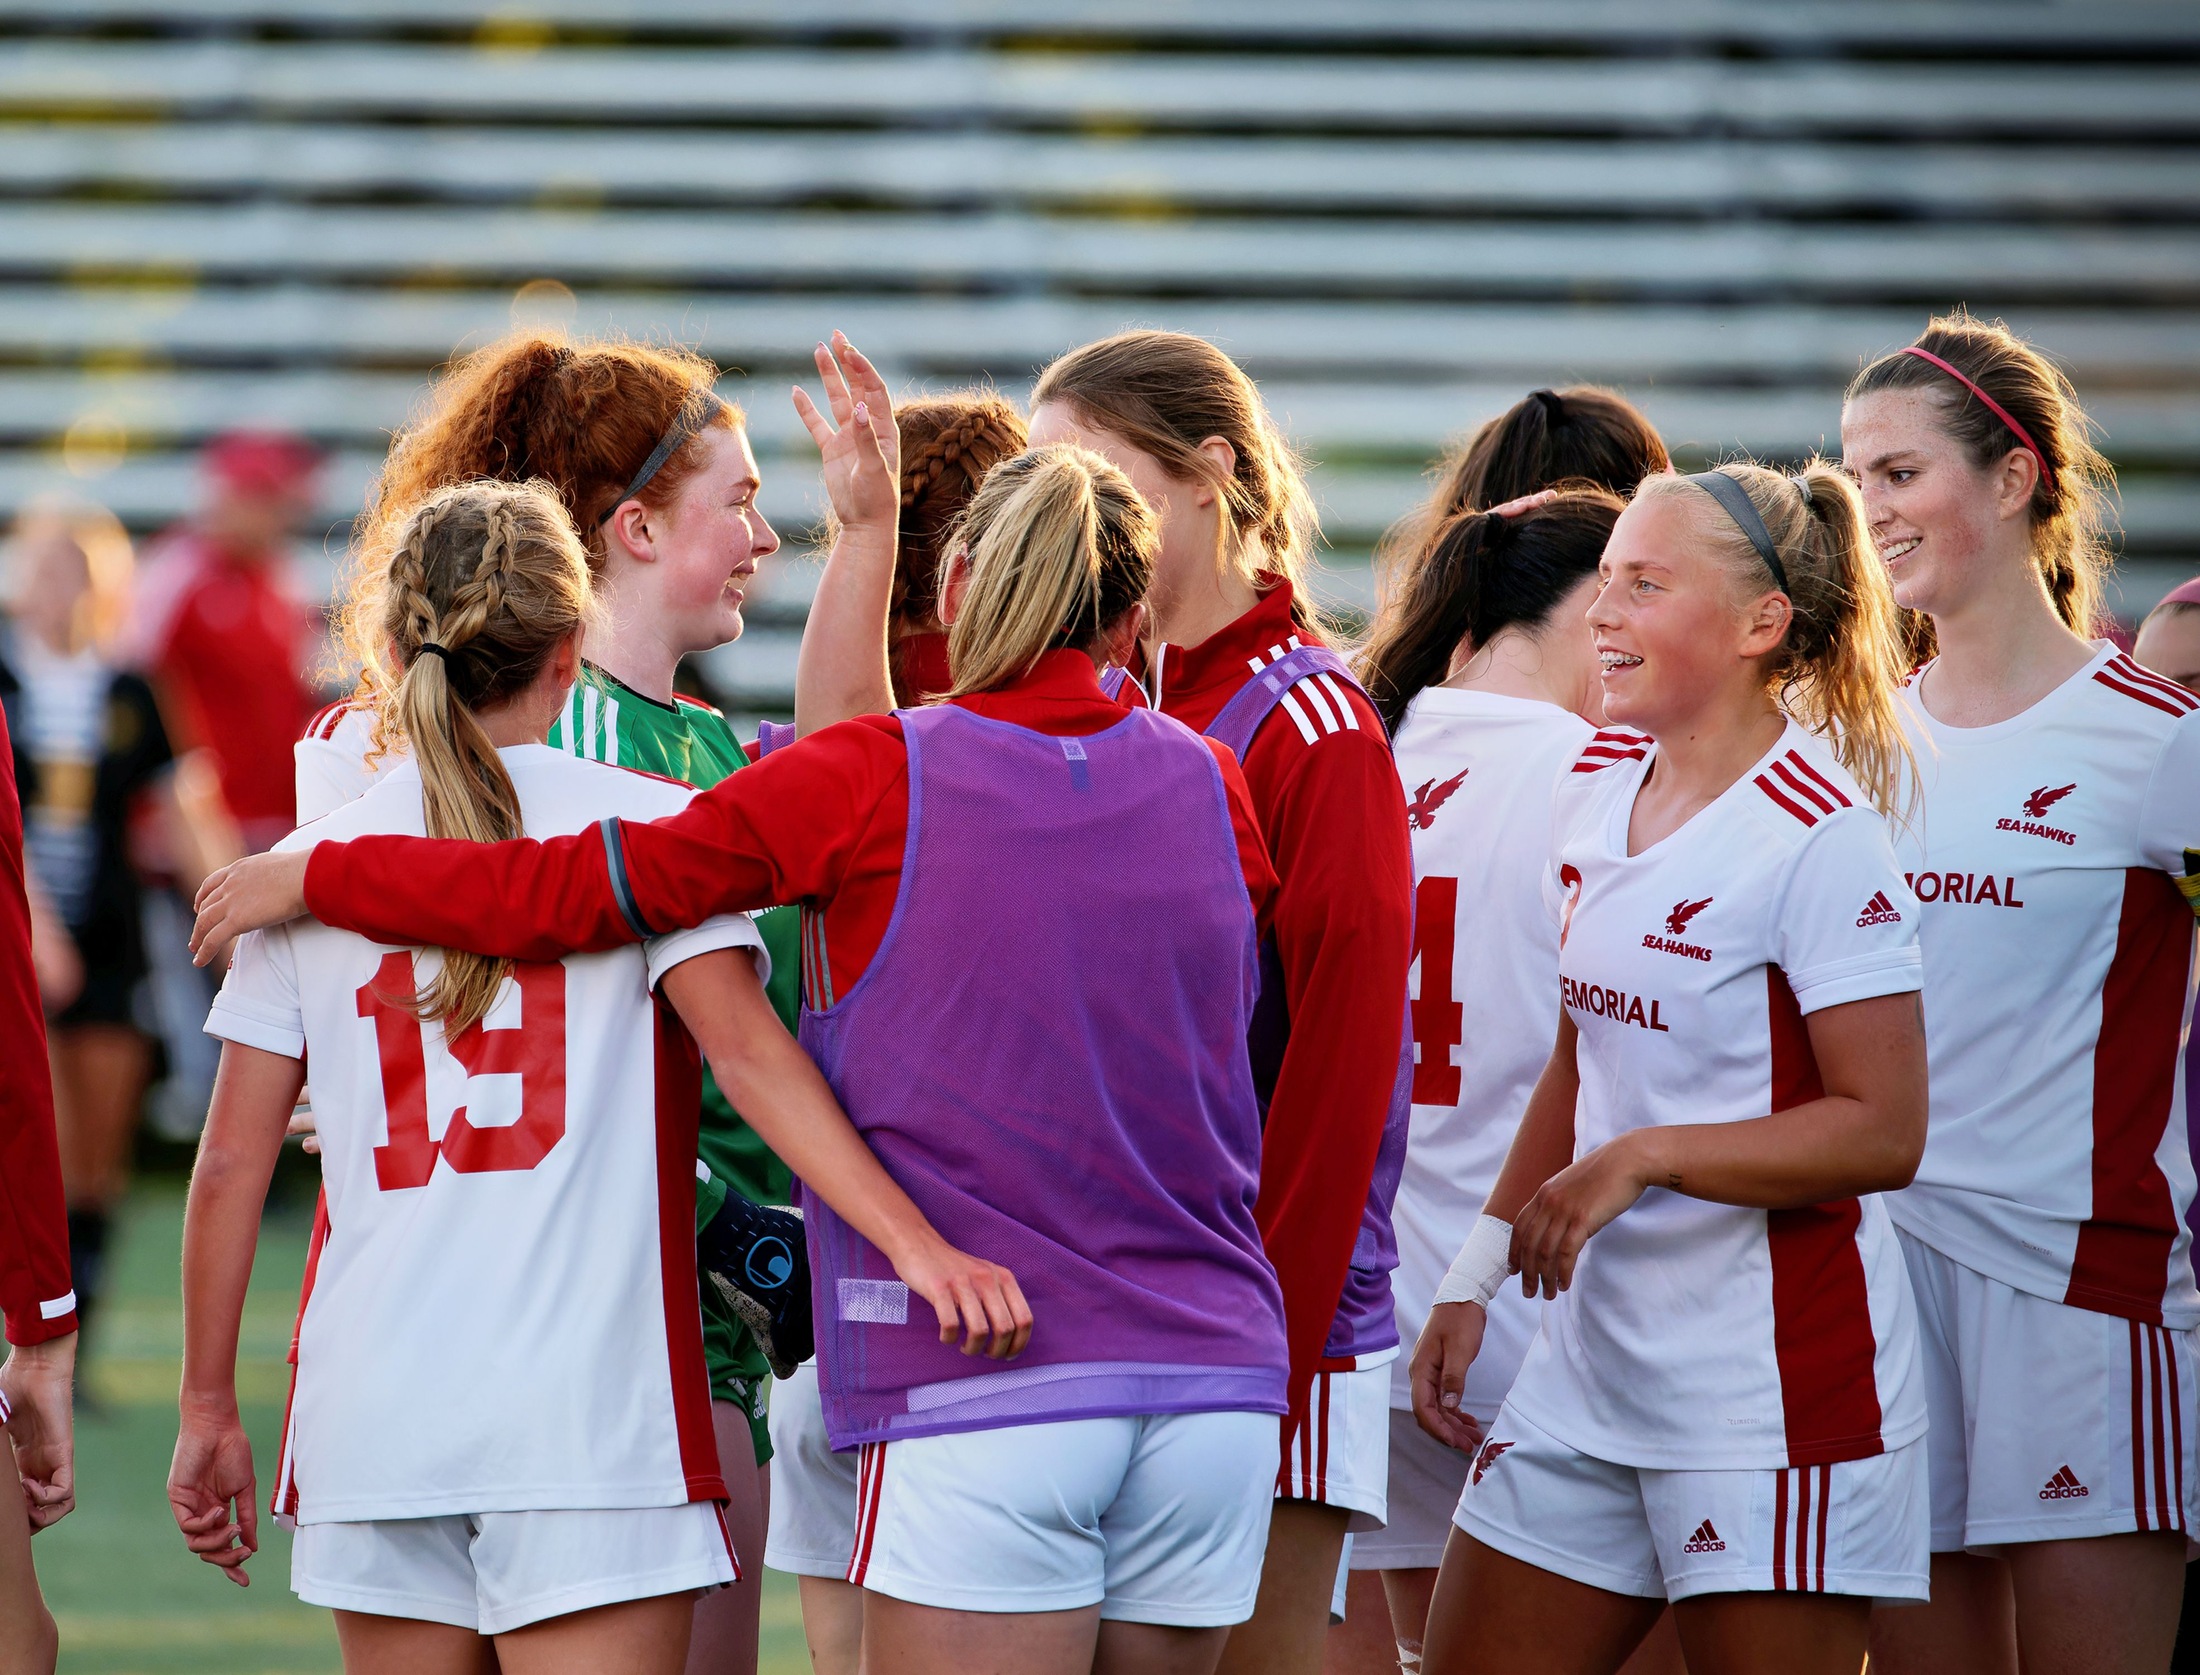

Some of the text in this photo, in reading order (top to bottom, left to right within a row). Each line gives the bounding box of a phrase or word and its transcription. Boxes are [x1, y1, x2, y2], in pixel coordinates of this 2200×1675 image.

[1904, 871, 2024, 908] ORIAL
[1856, 911, 1902, 928] adidas
[1559, 973, 1669, 1033] EMORIAL
[355, 950, 567, 1192] 19
[2039, 1486, 2089, 1500] adidas
[1683, 1540, 1726, 1554] adidas
